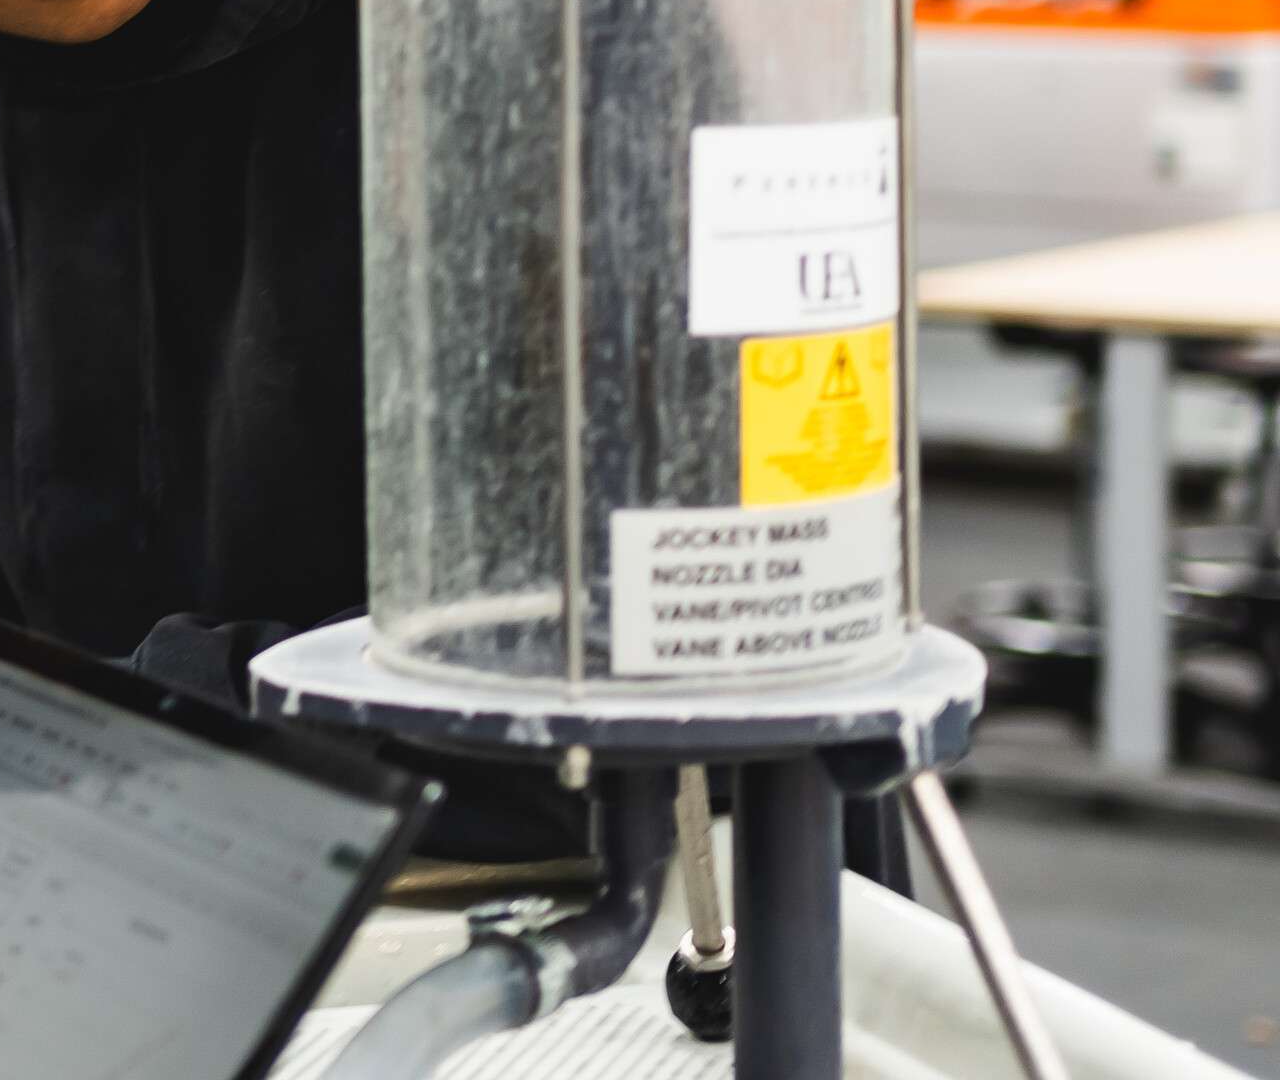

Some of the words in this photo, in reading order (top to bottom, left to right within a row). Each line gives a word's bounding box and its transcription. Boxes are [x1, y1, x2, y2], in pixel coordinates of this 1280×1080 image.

[652, 525, 761, 550] JOCKEY
[767, 518, 829, 543] MASS
[650, 559, 755, 585] NOZZLE
[764, 559, 803, 581] DIA
[652, 593, 802, 622] VANE/PIVOT
[652, 637, 721, 659] VANE
[733, 629, 813, 655] ABOVE
